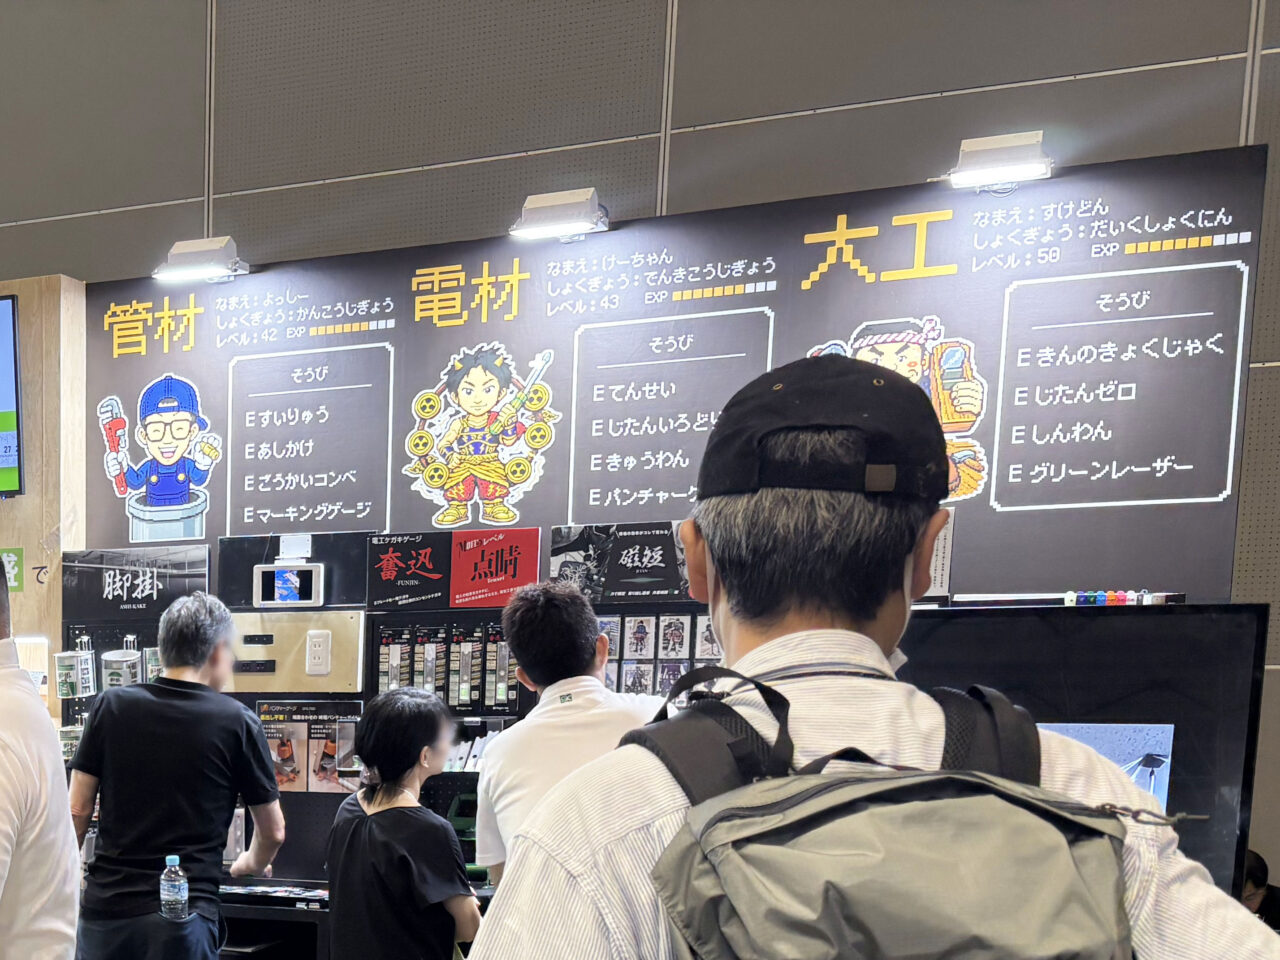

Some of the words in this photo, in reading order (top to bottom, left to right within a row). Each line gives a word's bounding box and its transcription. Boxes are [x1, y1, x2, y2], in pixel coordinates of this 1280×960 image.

[801, 210, 958, 290] 大工
[1091, 242, 1119, 258] EXP
[412, 257, 531, 328] 電材
[645, 291, 668, 305] EXP
[1096, 290, 1151, 312] そうび
[104, 293, 205, 358] 管材
[286, 327, 306, 339] EXP
[649, 333, 694, 354] そうび
[1036, 333, 1224, 368] きんのきょくじゃく
[291, 365, 329, 384] そうび
[608, 381, 677, 403] てんせい
[1034, 380, 1136, 405] じたんゼロ
[258, 405, 329, 428] すいりゅう
[1032, 420, 1112, 445] しんわん
[3, 445, 12, 454] 27
[257, 438, 314, 461] あしかけ
[606, 449, 690, 473] きゅうわん
[1030, 456, 1193, 484] グリーンレーザー
[257, 501, 372, 523] マーキングゲージ
